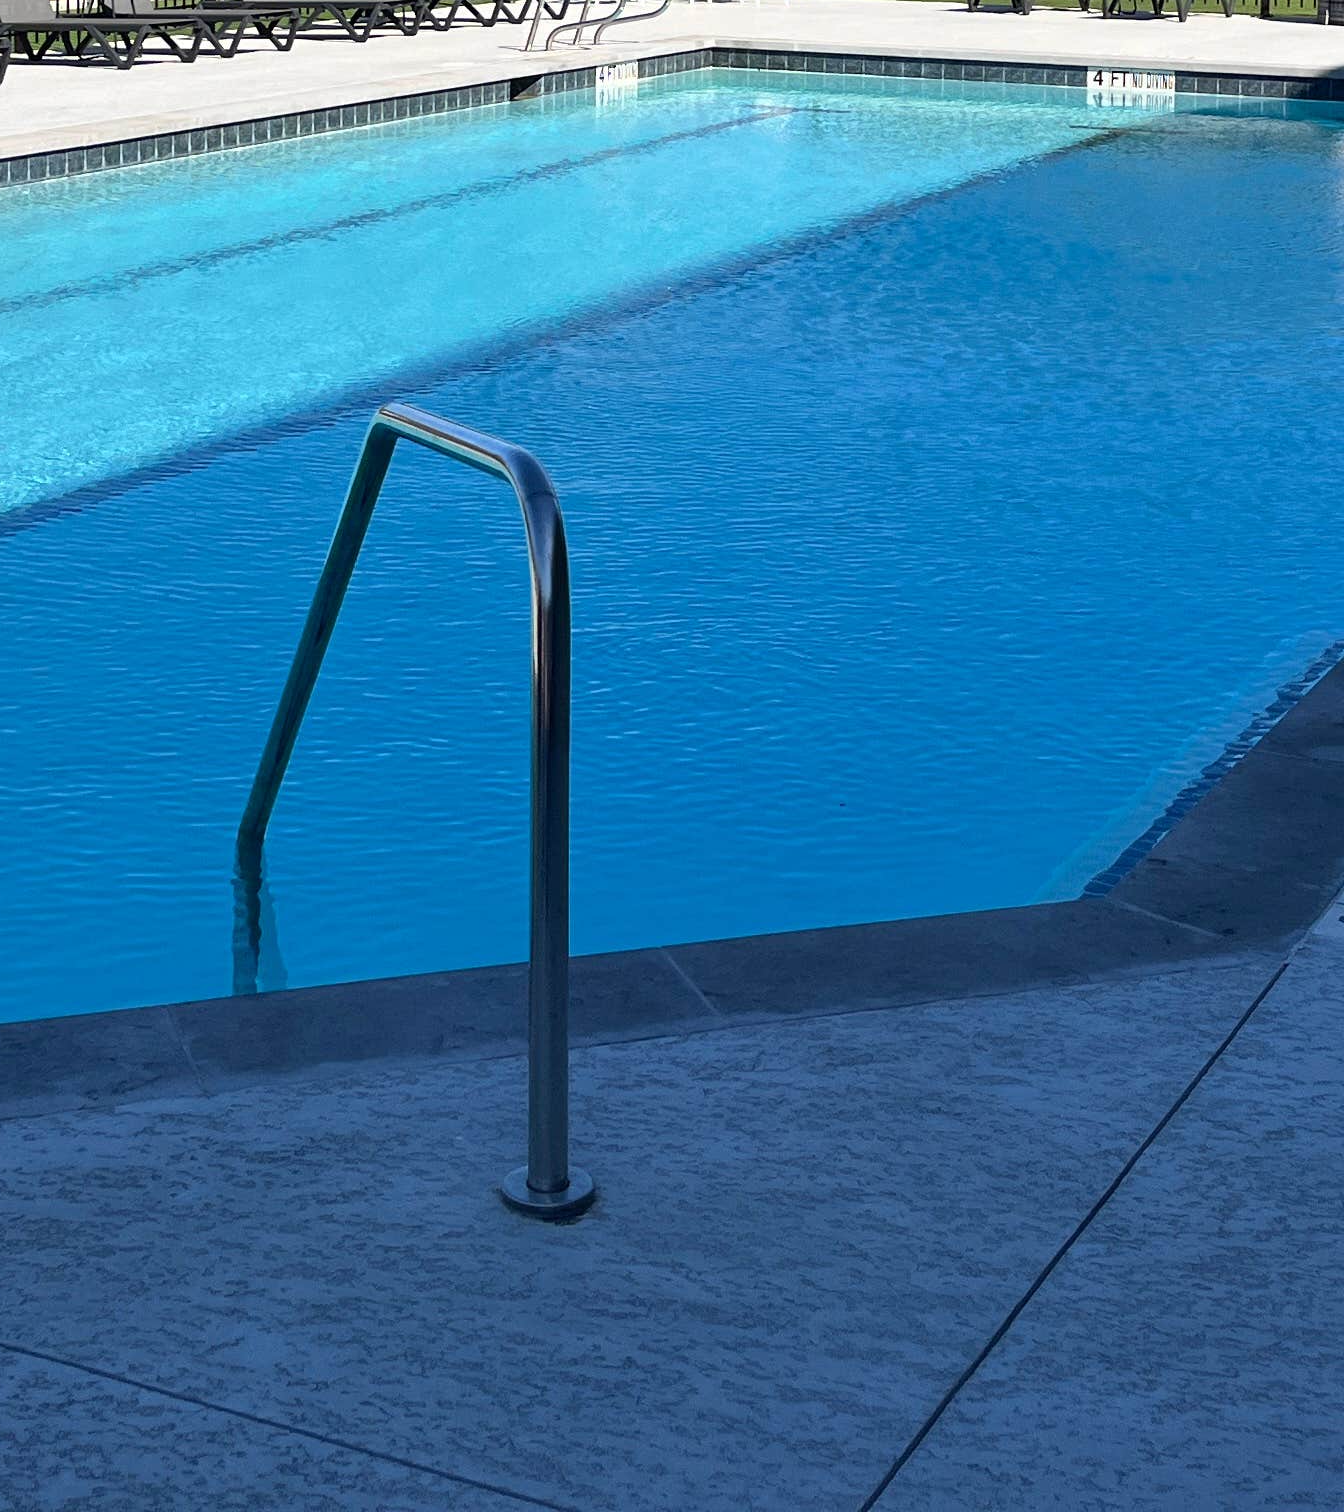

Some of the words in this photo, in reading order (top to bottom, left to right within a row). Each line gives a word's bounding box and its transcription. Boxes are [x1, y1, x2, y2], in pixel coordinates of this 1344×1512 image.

[1093, 69, 1103, 86] 4
[1111, 70, 1129, 87] FT
[1132, 72, 1143, 88] NO
[1146, 72, 1173, 89] DIVING
